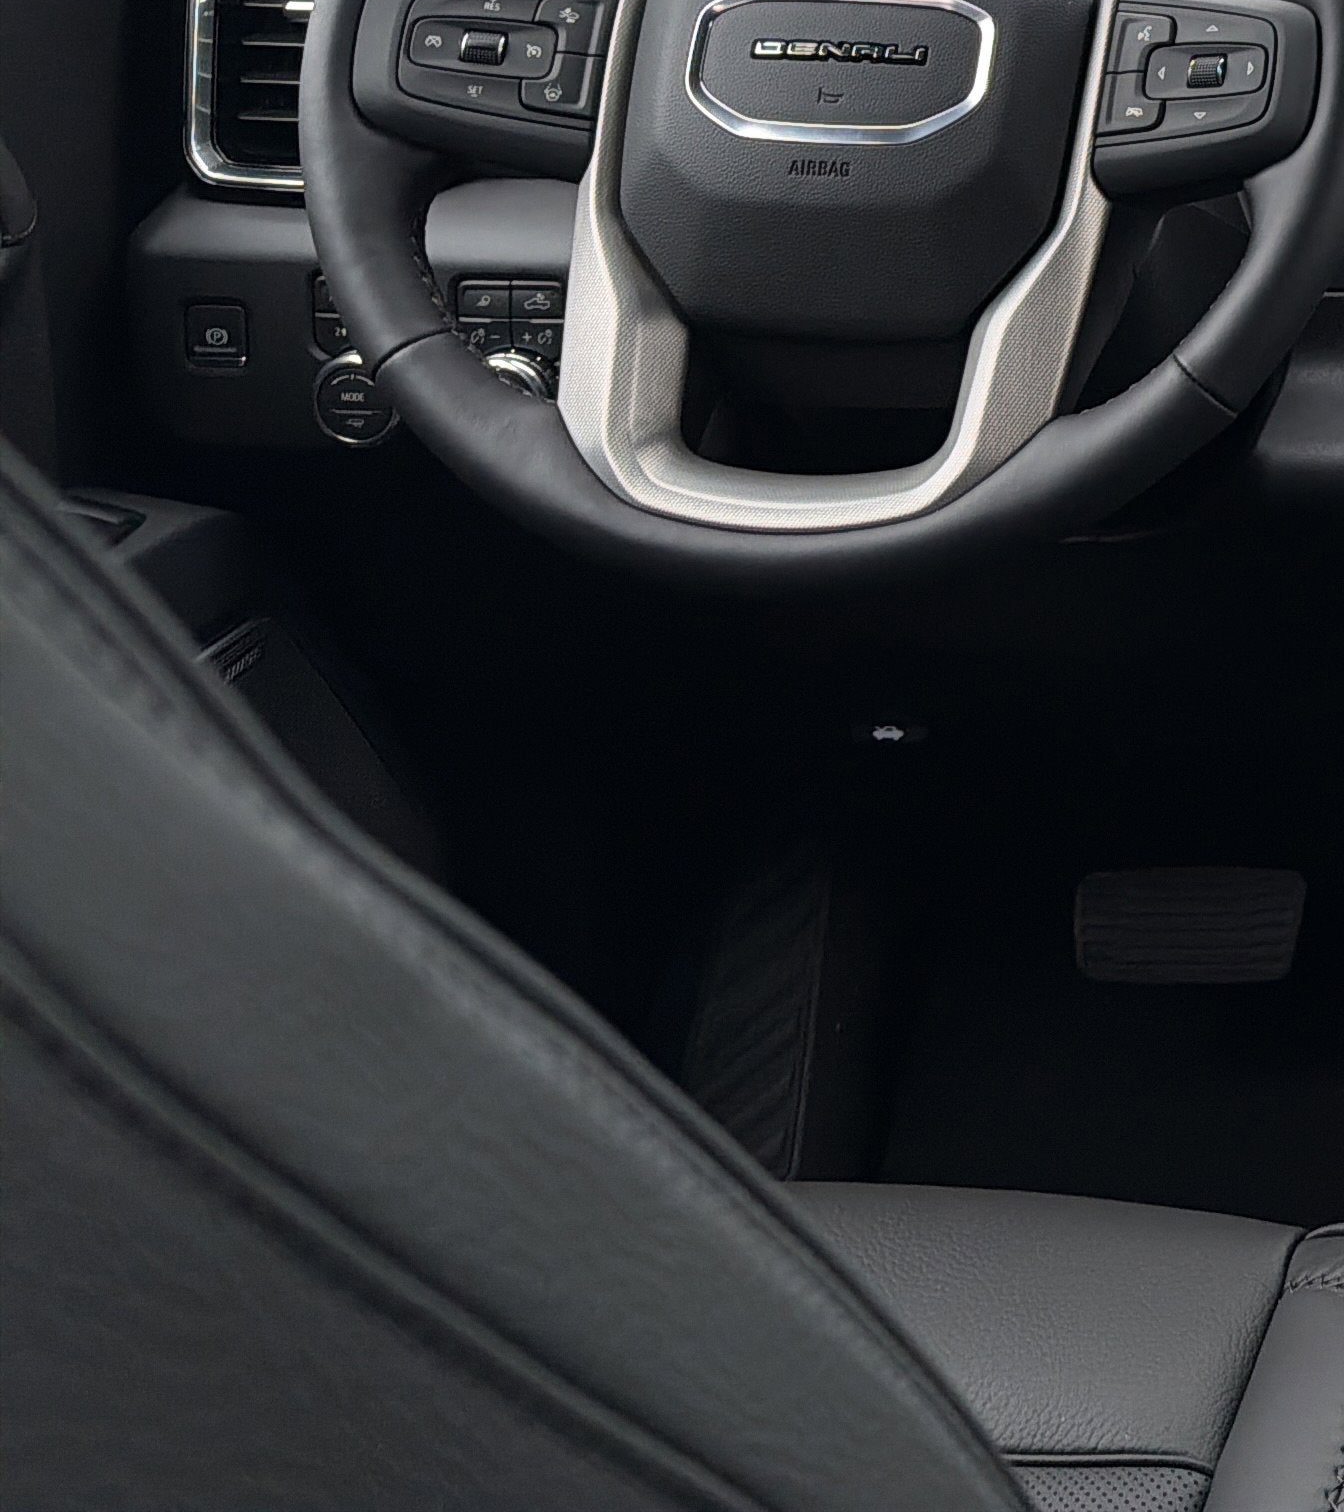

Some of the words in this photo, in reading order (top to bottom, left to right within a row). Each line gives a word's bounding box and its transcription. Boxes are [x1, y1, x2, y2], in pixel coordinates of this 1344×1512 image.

[483, 1, 501, 12] RES
[752, 38, 929, 66] DENALI
[467, 85, 484, 94] SET
[788, 160, 851, 178] AIRBAG
[341, 392, 365, 402] MODE
